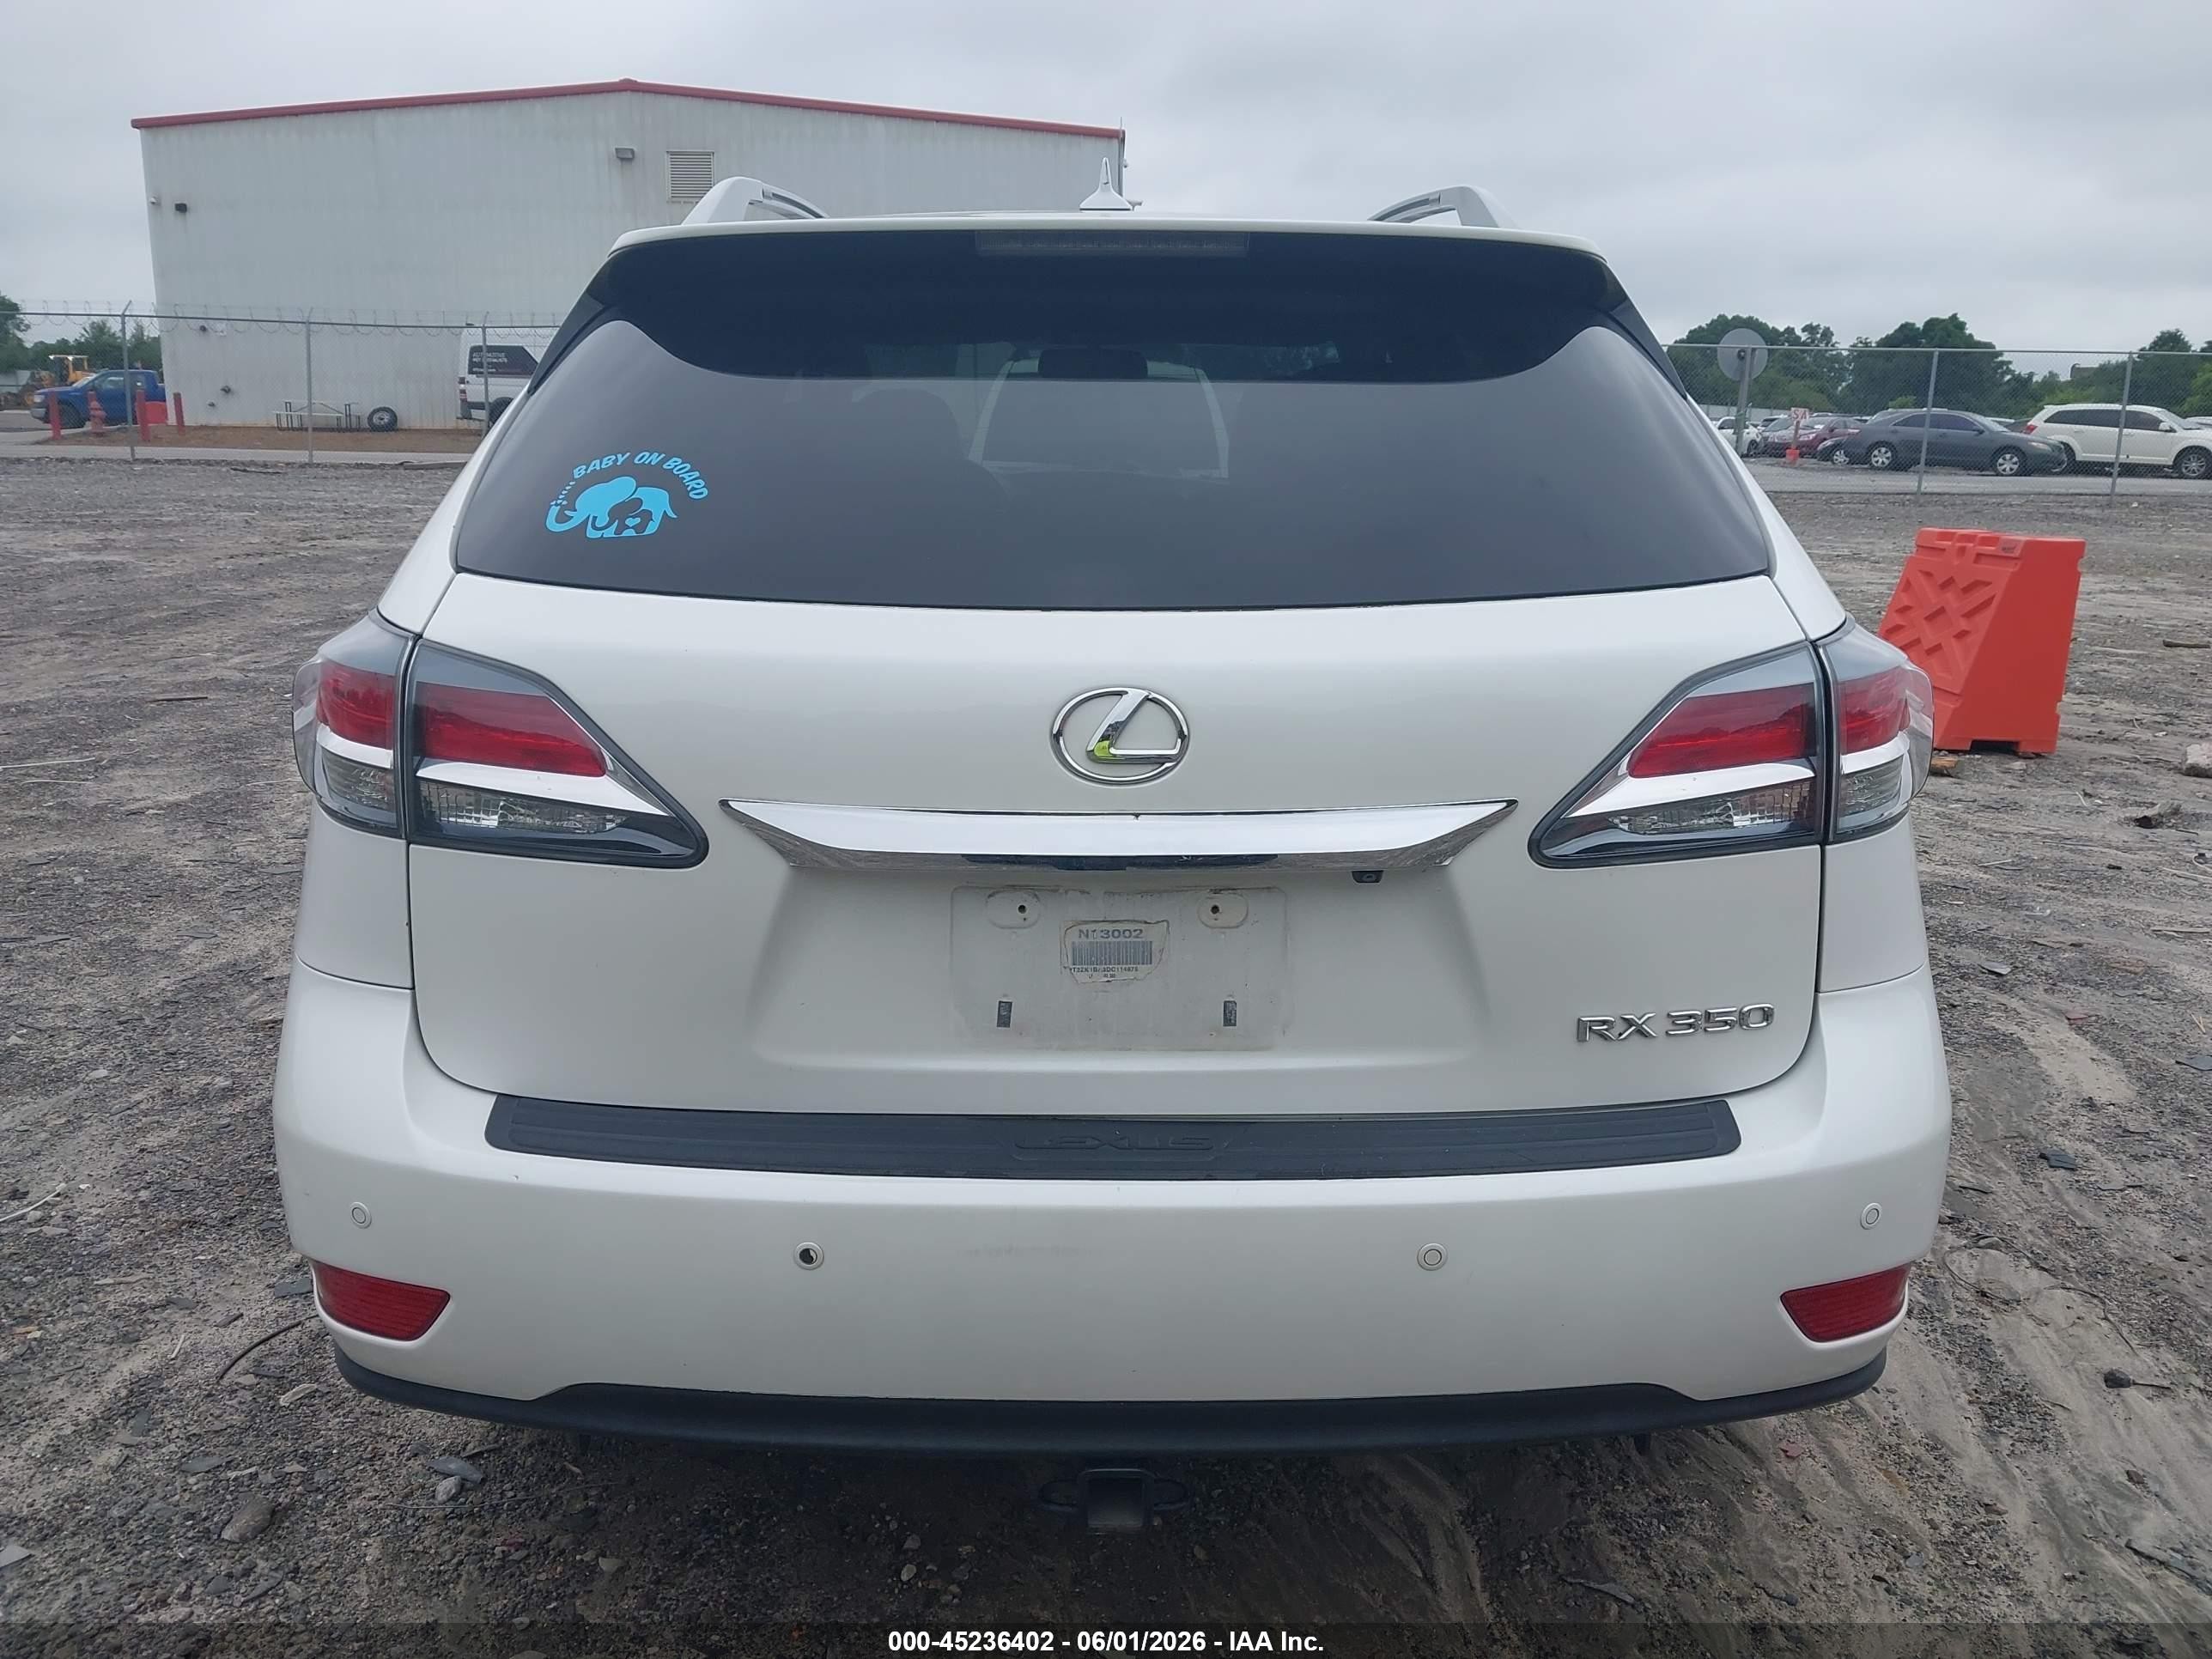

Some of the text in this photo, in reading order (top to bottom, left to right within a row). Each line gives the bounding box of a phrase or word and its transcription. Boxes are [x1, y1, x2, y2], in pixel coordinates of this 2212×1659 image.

[573, 451, 708, 500] BABY ON BOARD
[1577, 1003, 1775, 1042] RX 350
